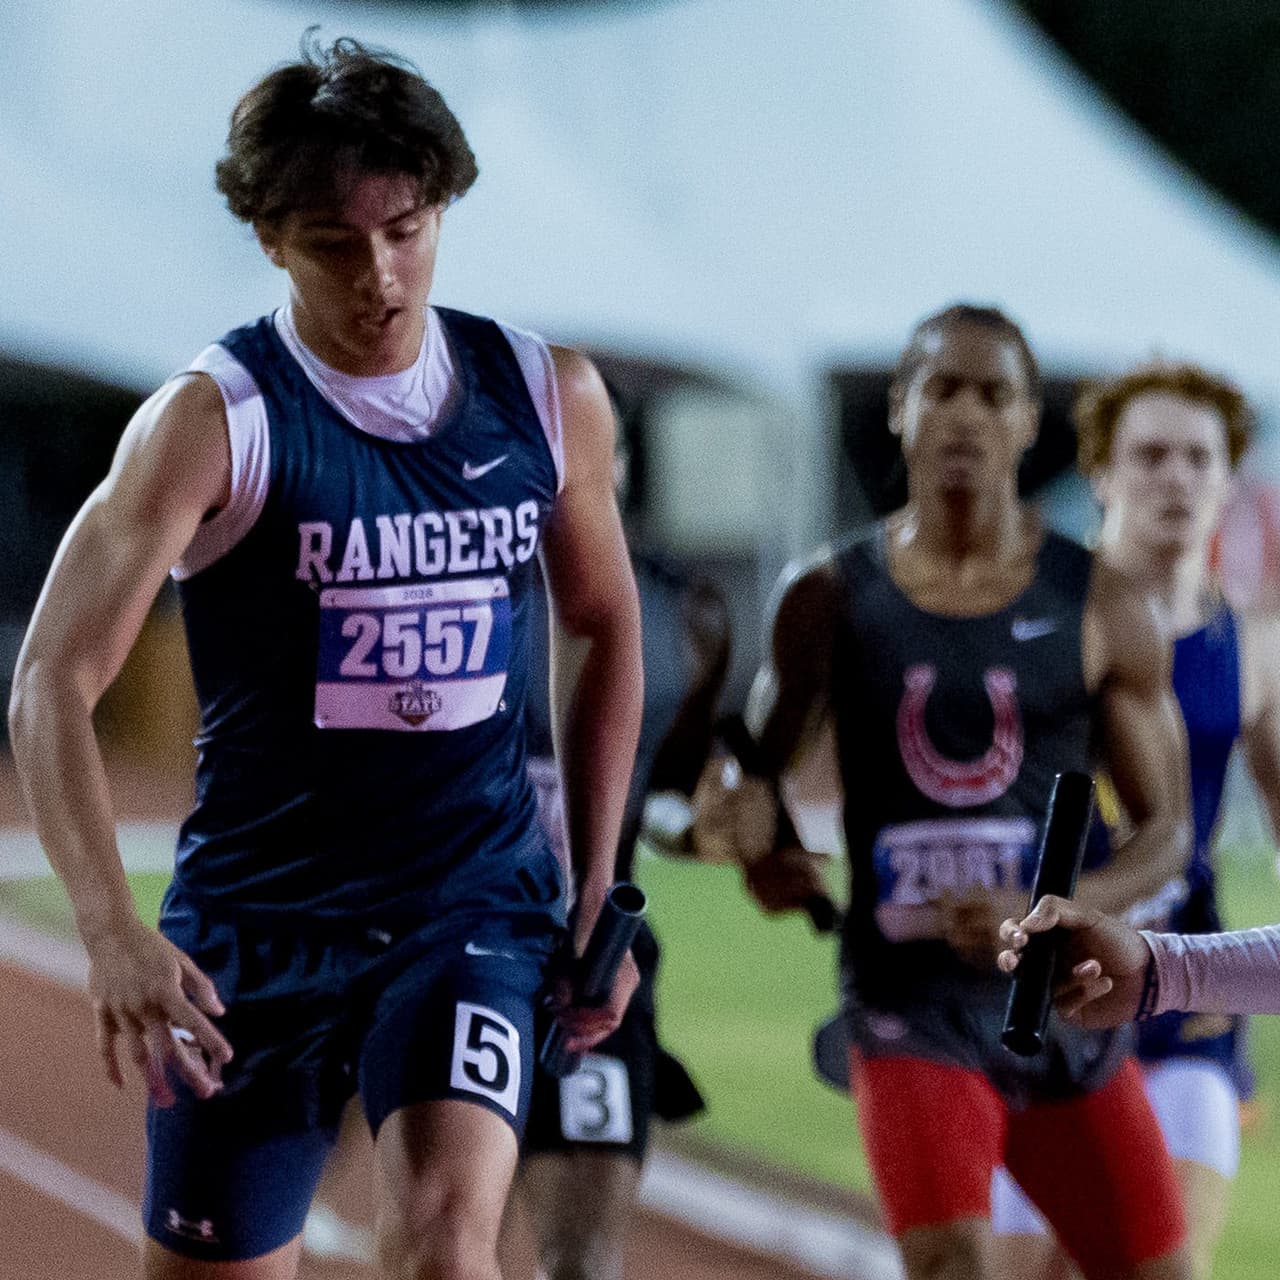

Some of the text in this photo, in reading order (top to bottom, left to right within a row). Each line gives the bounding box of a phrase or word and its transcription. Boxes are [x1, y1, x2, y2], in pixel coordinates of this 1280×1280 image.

[296, 499, 539, 584] RANGERS
[339, 606, 494, 678] 2557
[463, 1012, 509, 1093] 5
[574, 1070, 609, 1135] 3
